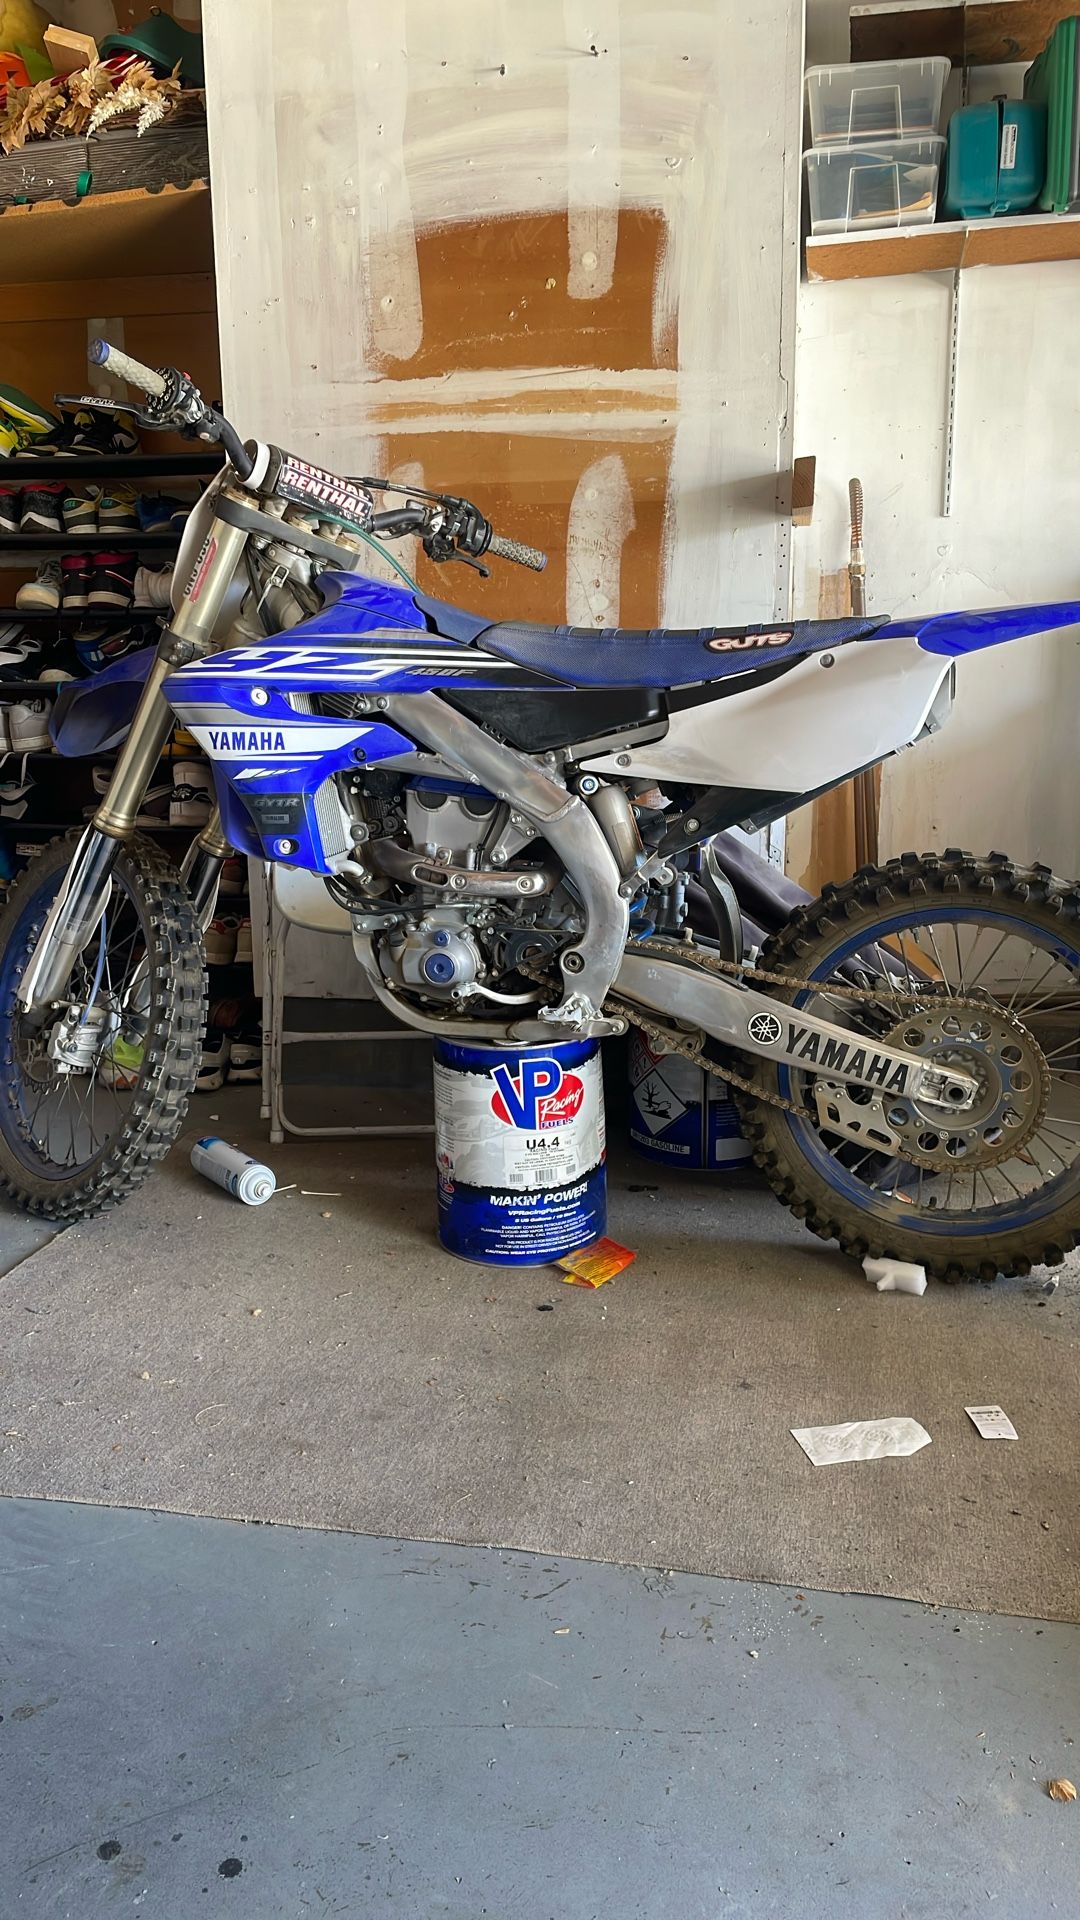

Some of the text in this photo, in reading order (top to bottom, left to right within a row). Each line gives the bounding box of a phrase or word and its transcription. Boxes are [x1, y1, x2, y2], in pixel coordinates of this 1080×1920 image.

[287, 456, 370, 501] RENTHAL
[283, 470, 368, 517] RENTHAL
[709, 632, 792, 651] GUTS
[405, 667, 478, 676] 450F
[208, 731, 286, 751] YAMAHA
[785, 1023, 909, 1094] YAMAHA
[490, 1057, 563, 1130] VP
[540, 1088, 583, 1121] Racing
[541, 1118, 573, 1129] FUELS
[526, 1136, 560, 1150] U4.4
[651, 1139, 685, 1153] GASOLINE
[490, 1194, 541, 1206] MAKIN'
